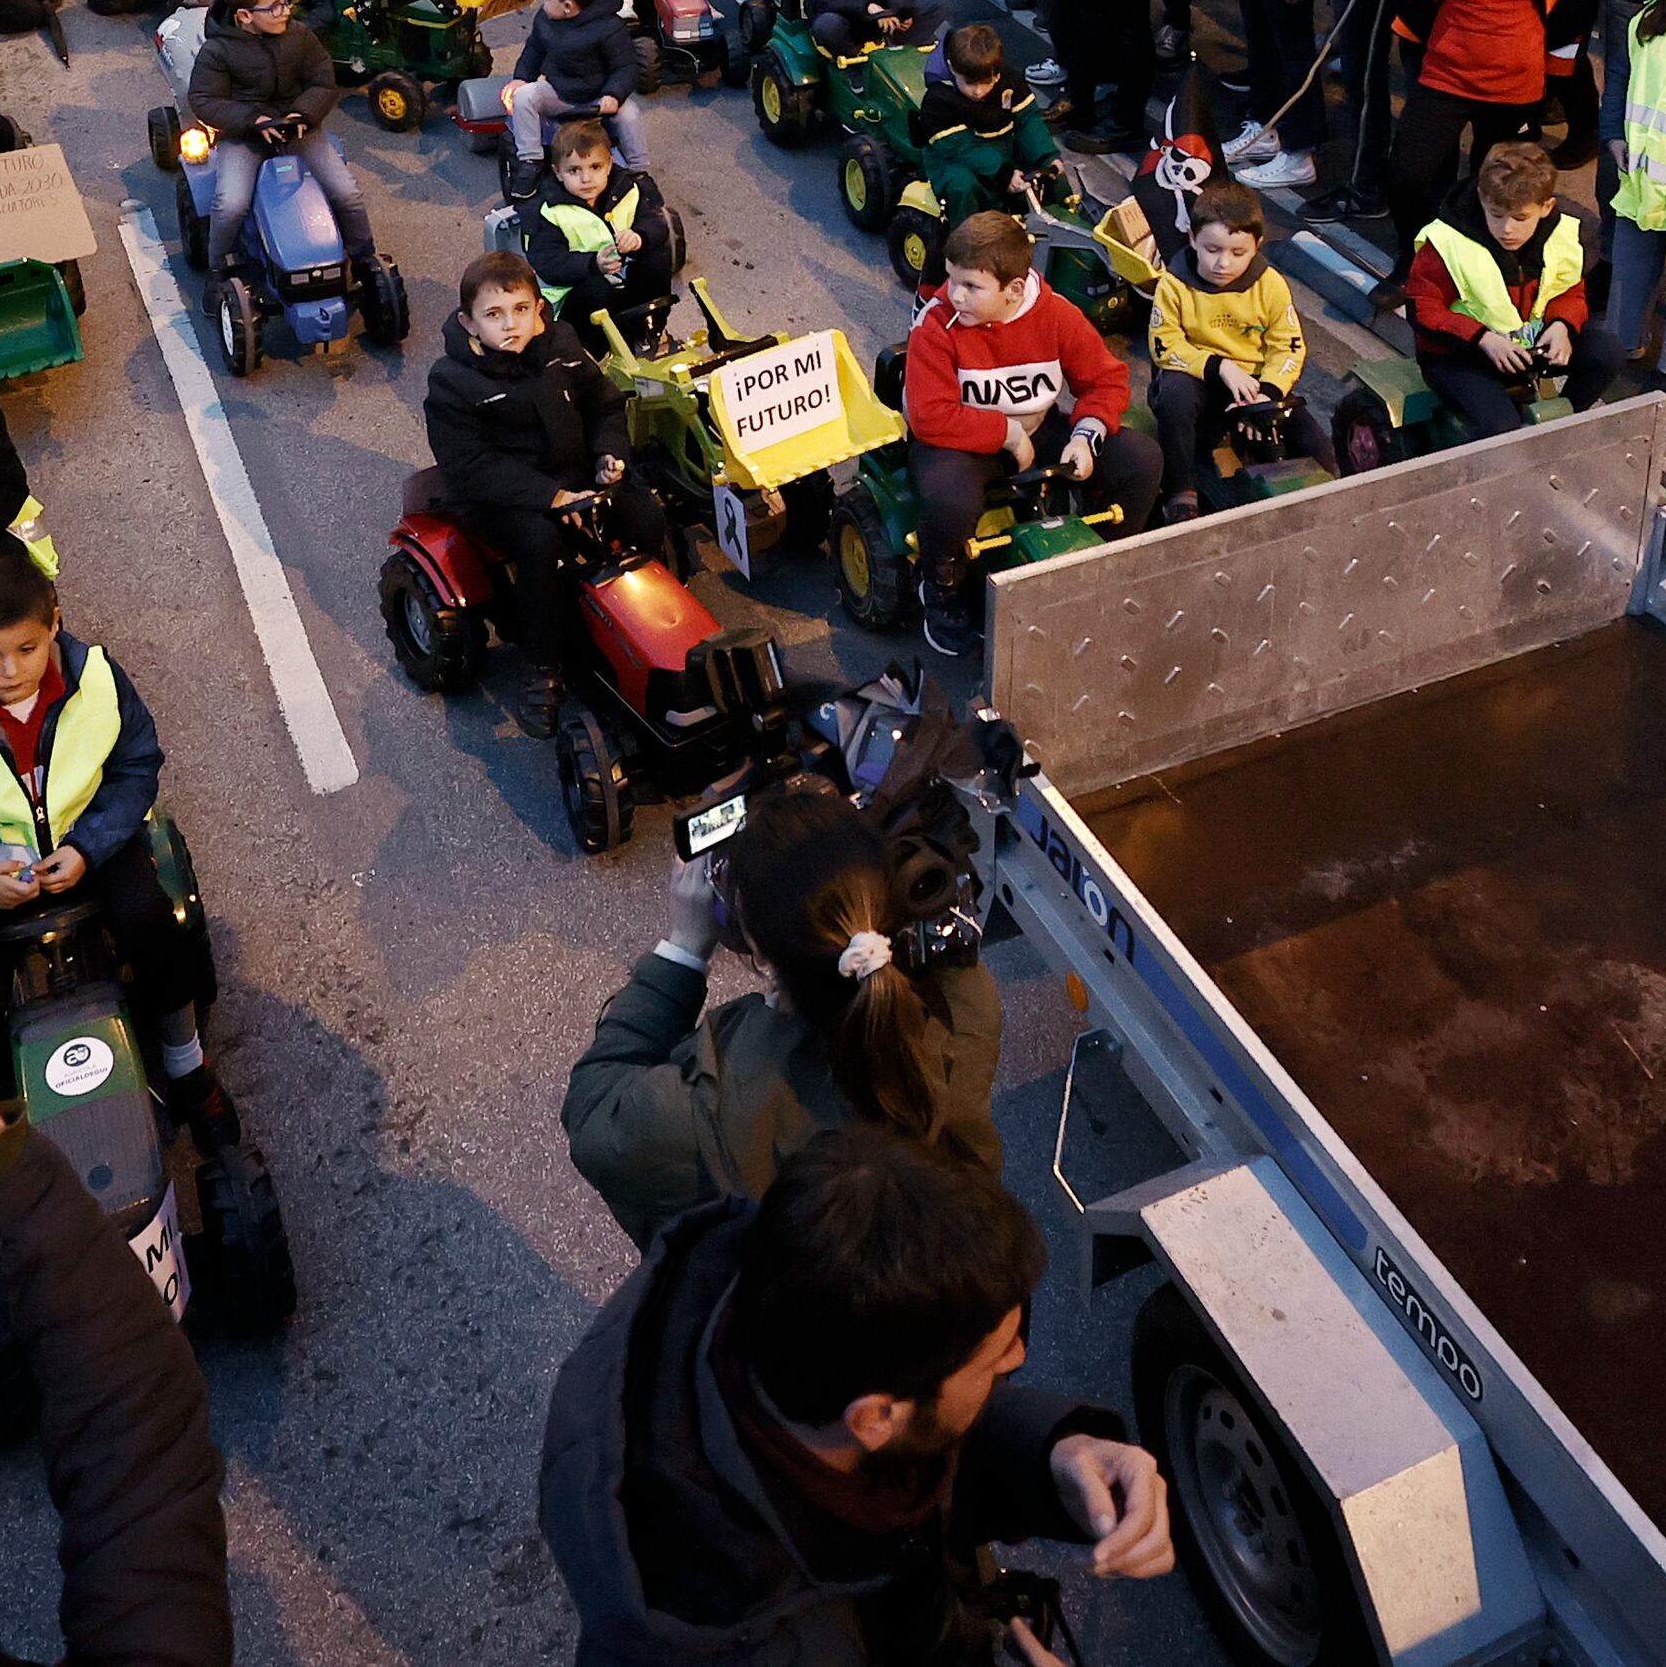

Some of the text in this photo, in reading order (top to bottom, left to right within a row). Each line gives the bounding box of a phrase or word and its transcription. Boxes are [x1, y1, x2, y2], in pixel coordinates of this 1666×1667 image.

[22, 172, 64, 195] 2030
[735, 350, 822, 402] ¡POR MI
[962, 372, 1056, 405] NASA
[736, 384, 831, 438] FUTURO!
[1375, 1248, 1481, 1400] tempo
